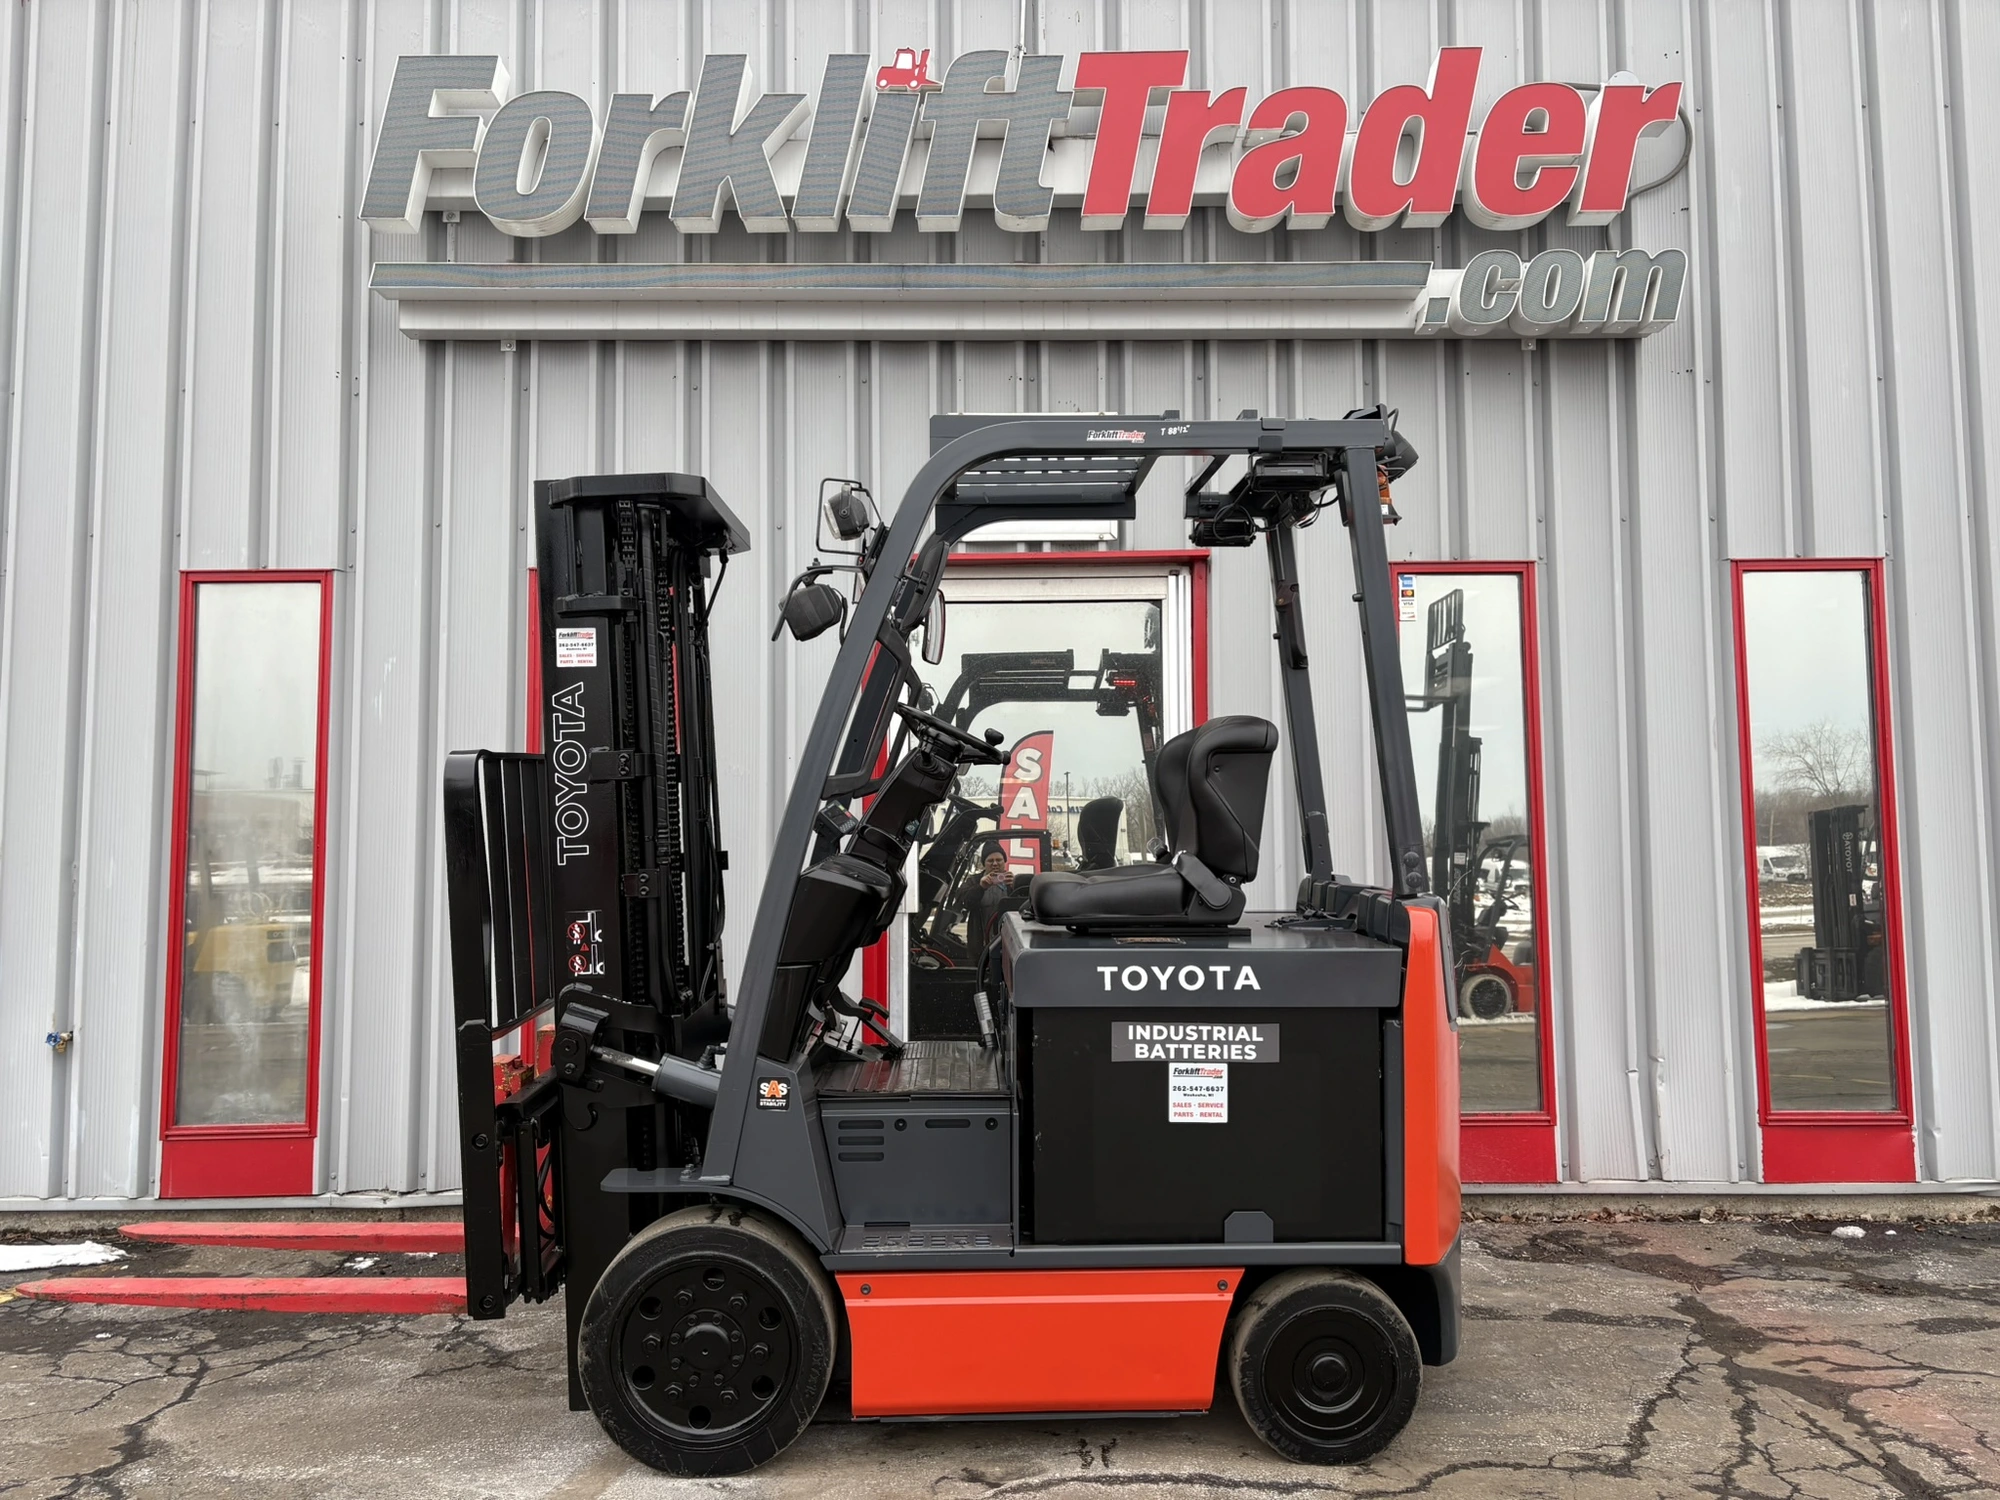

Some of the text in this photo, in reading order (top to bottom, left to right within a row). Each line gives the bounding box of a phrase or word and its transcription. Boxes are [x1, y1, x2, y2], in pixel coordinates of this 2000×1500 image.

[1420, 247, 1689, 330] .com
[552, 681, 590, 866] TOYOTA
[1097, 965, 1261, 991] TOYOTA
[1128, 1025, 1264, 1041] INDUSTRIAL
[1135, 1044, 1257, 1060] BATTERIES
[1173, 1067, 1224, 1075] ForkliftTrader
[760, 1080, 788, 1098] SAS
